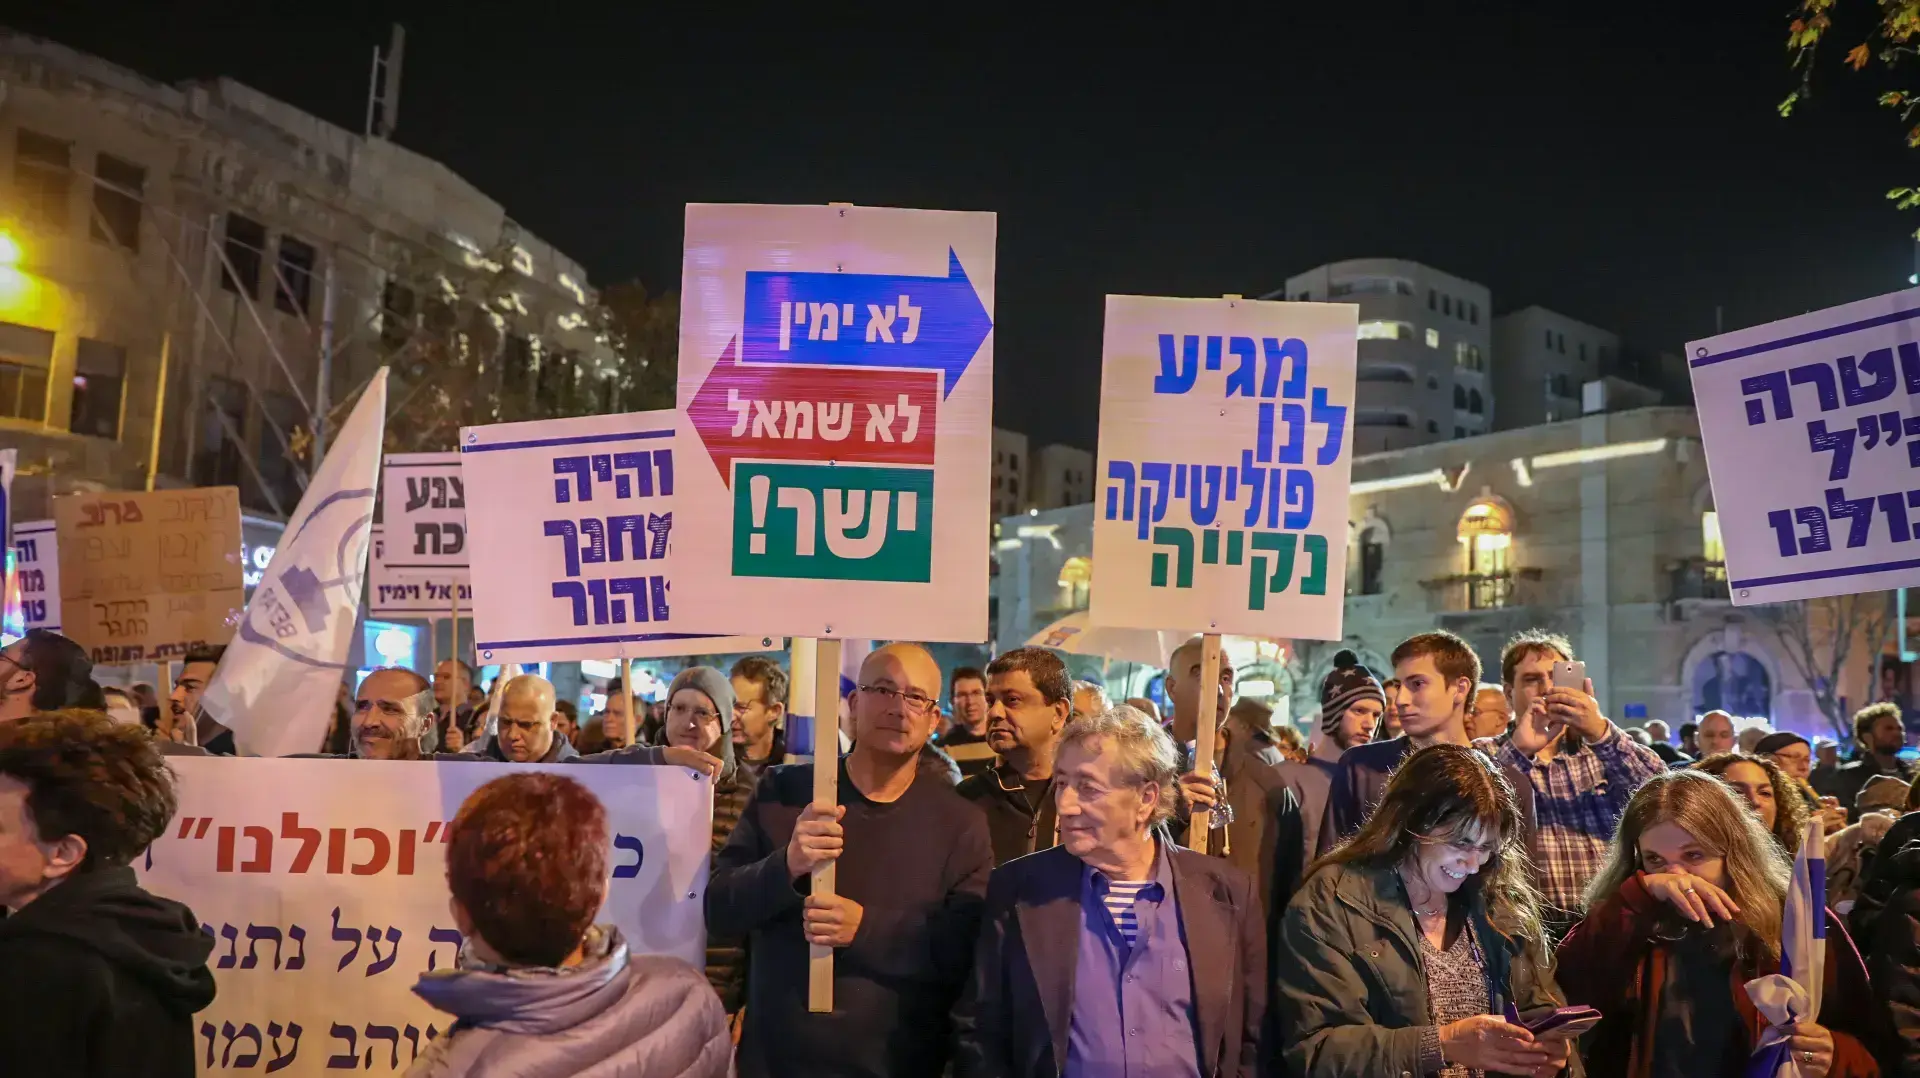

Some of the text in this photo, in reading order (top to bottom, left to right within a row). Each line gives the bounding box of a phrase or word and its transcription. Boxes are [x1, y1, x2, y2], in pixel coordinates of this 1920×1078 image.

[778, 294, 922, 351] לא ימין
[1153, 333, 1309, 399] מגיע
[726, 388, 921, 443] לא שמאל
[1256, 387, 1348, 466] לנו
[552, 449, 674, 503] והיה
[1105, 449, 1315, 540] פוליטיקה
[414, 515, 467, 554] כת
[748, 474, 918, 559] ישר!
[378, 583, 419, 604] וימין
[1150, 526, 1329, 611] נקייה
[331, 906, 403, 978] על
[200, 1019, 440, 1074] והב עמו
